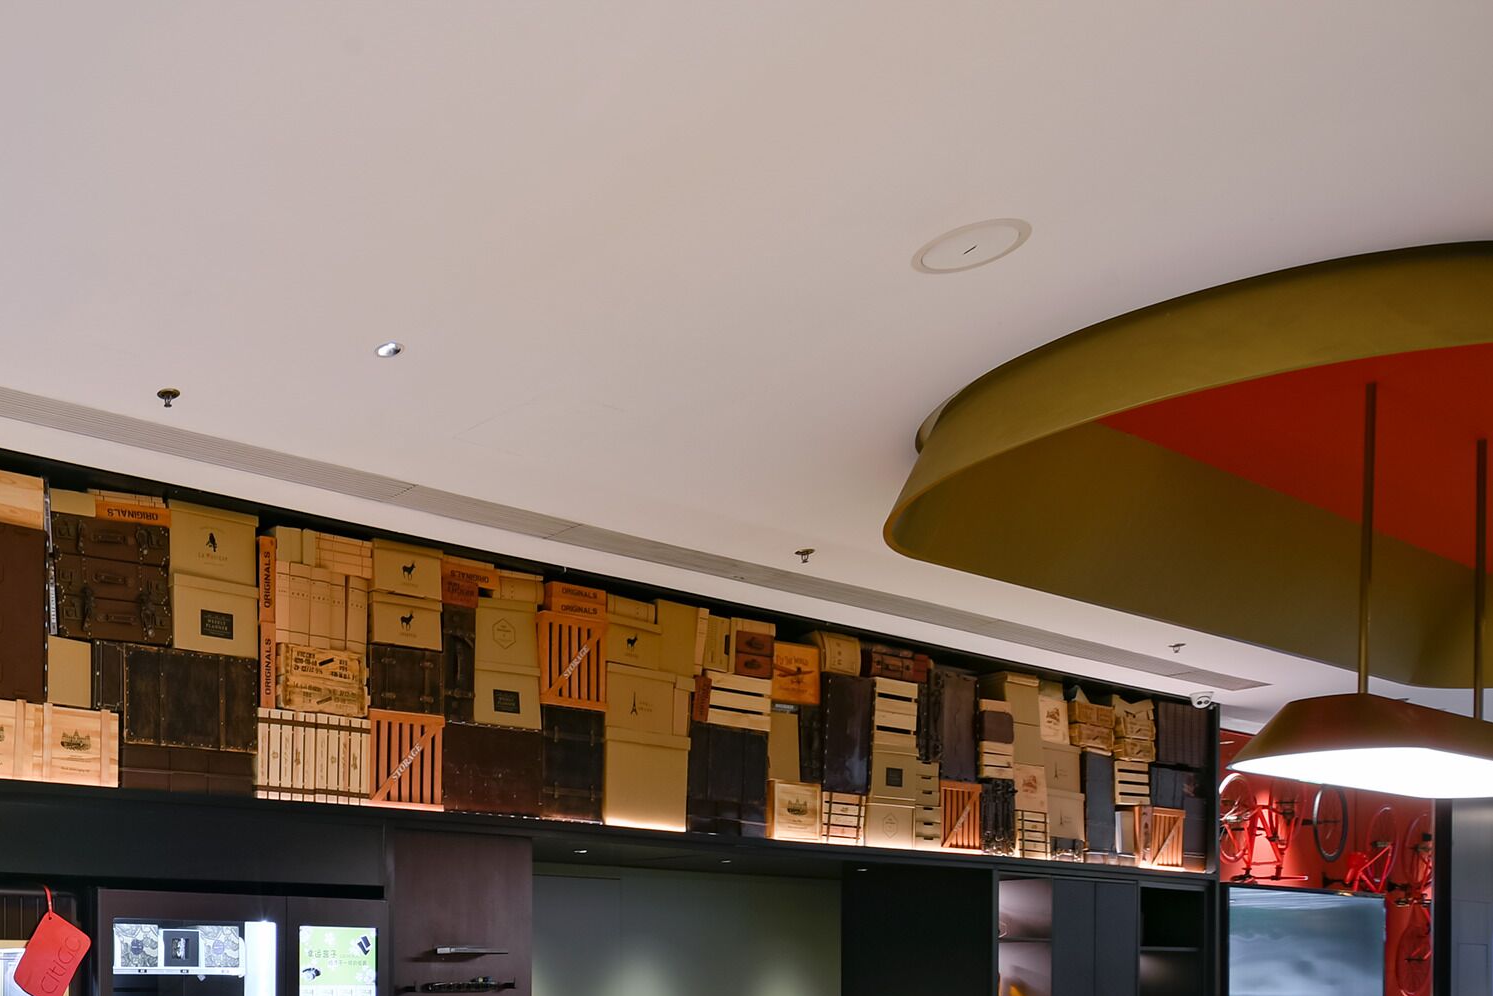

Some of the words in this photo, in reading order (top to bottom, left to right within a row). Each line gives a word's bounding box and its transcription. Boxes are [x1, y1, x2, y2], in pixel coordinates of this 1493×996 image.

[107, 507, 159, 521] ORIGINALS
[263, 551, 272, 609] ORIGINALS
[561, 586, 598, 600] ORIGINALS
[560, 604, 598, 615] ORIGINALS
[264, 637, 272, 696] ORIGINALS
[563, 644, 590, 680] STORAGE
[392, 743, 423, 782] STORAGE
